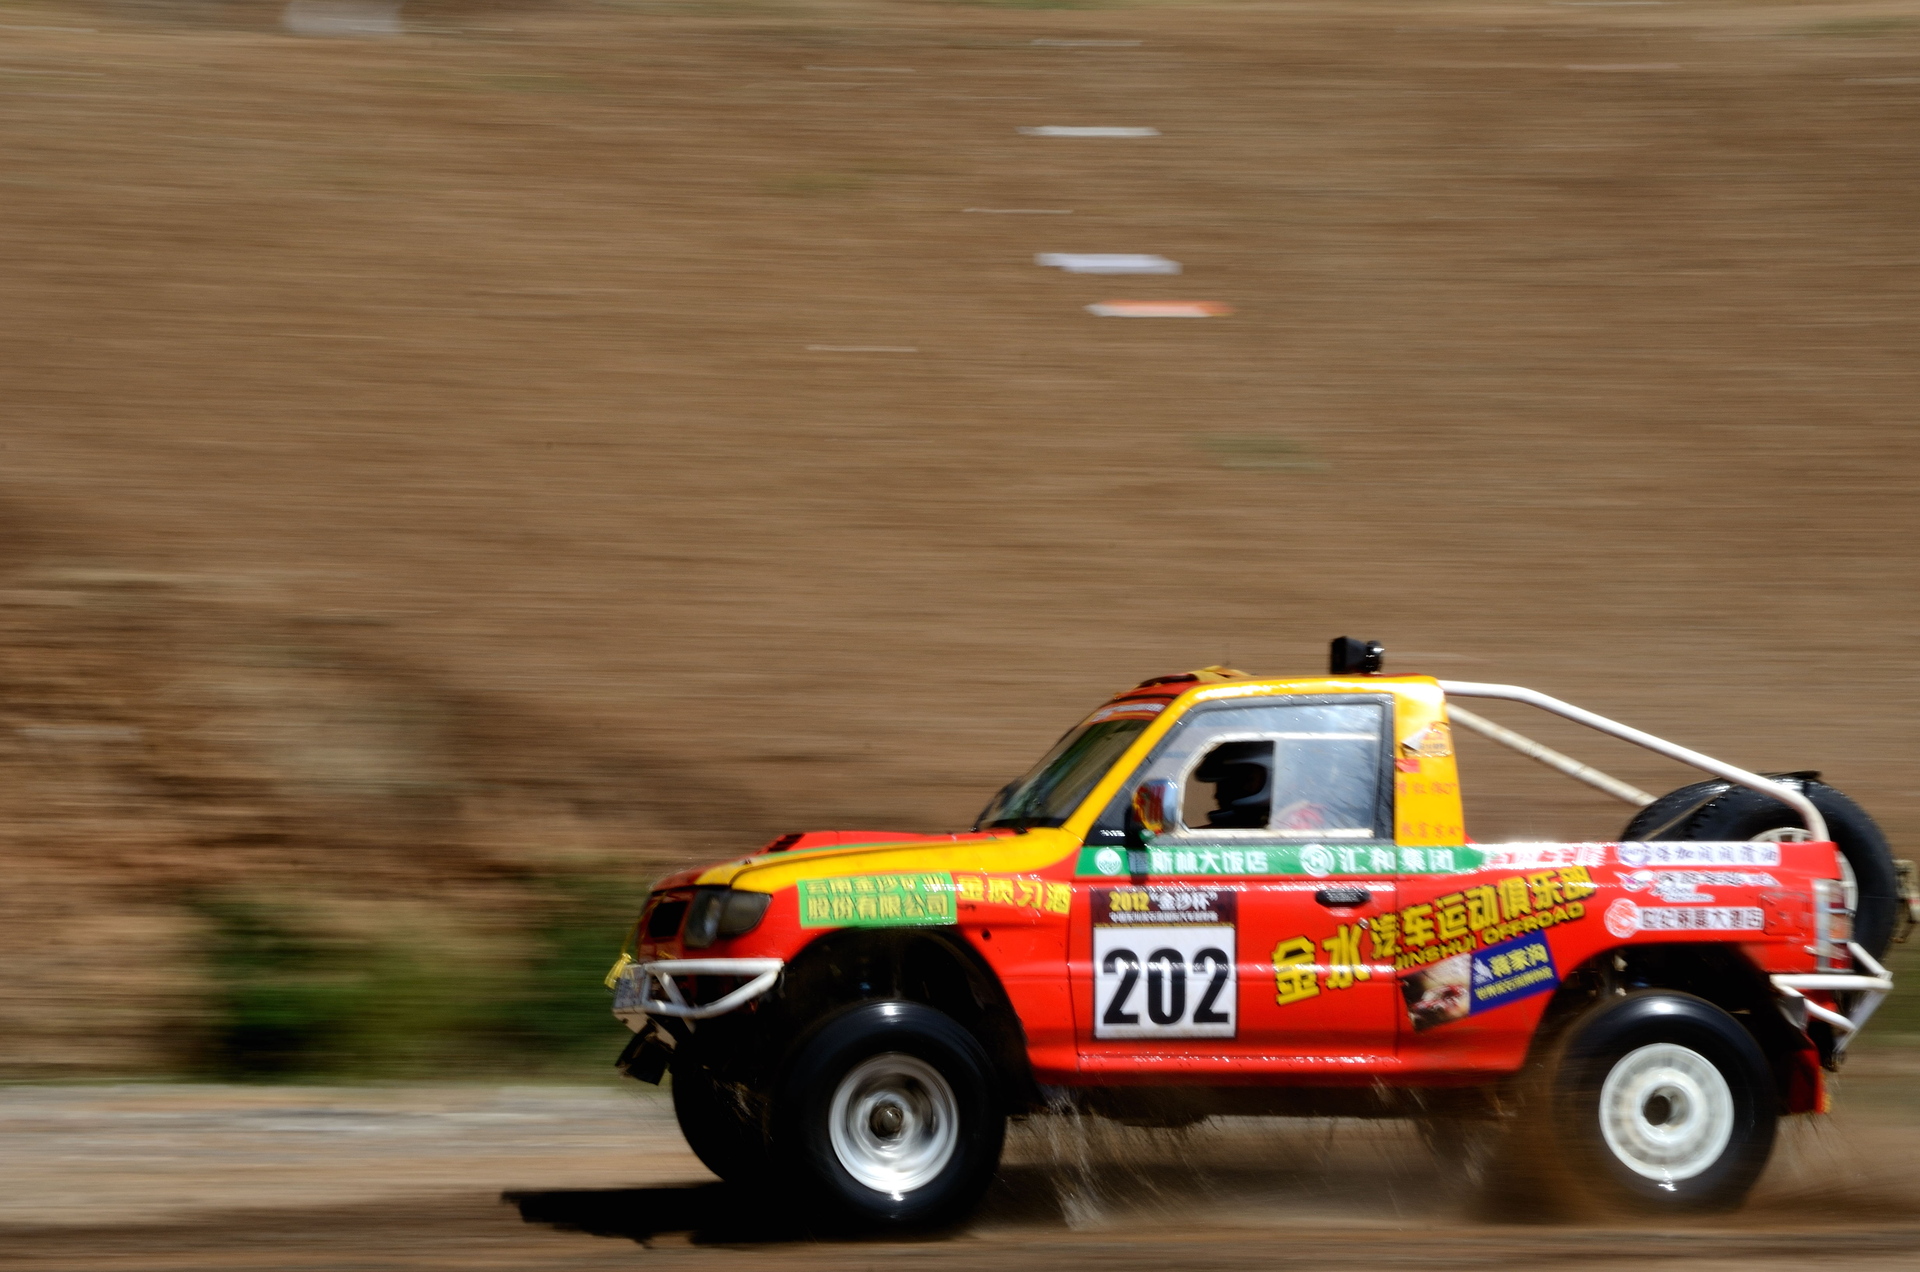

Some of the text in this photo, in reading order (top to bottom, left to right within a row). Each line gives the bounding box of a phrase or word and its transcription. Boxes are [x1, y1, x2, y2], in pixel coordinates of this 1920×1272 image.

[807, 893, 948, 920] 股份有限公司
[1109, 890, 1150, 911] 2012
[1394, 902, 1586, 970] JINSHUI OFFROAD
[1102, 948, 1230, 1025] 202
